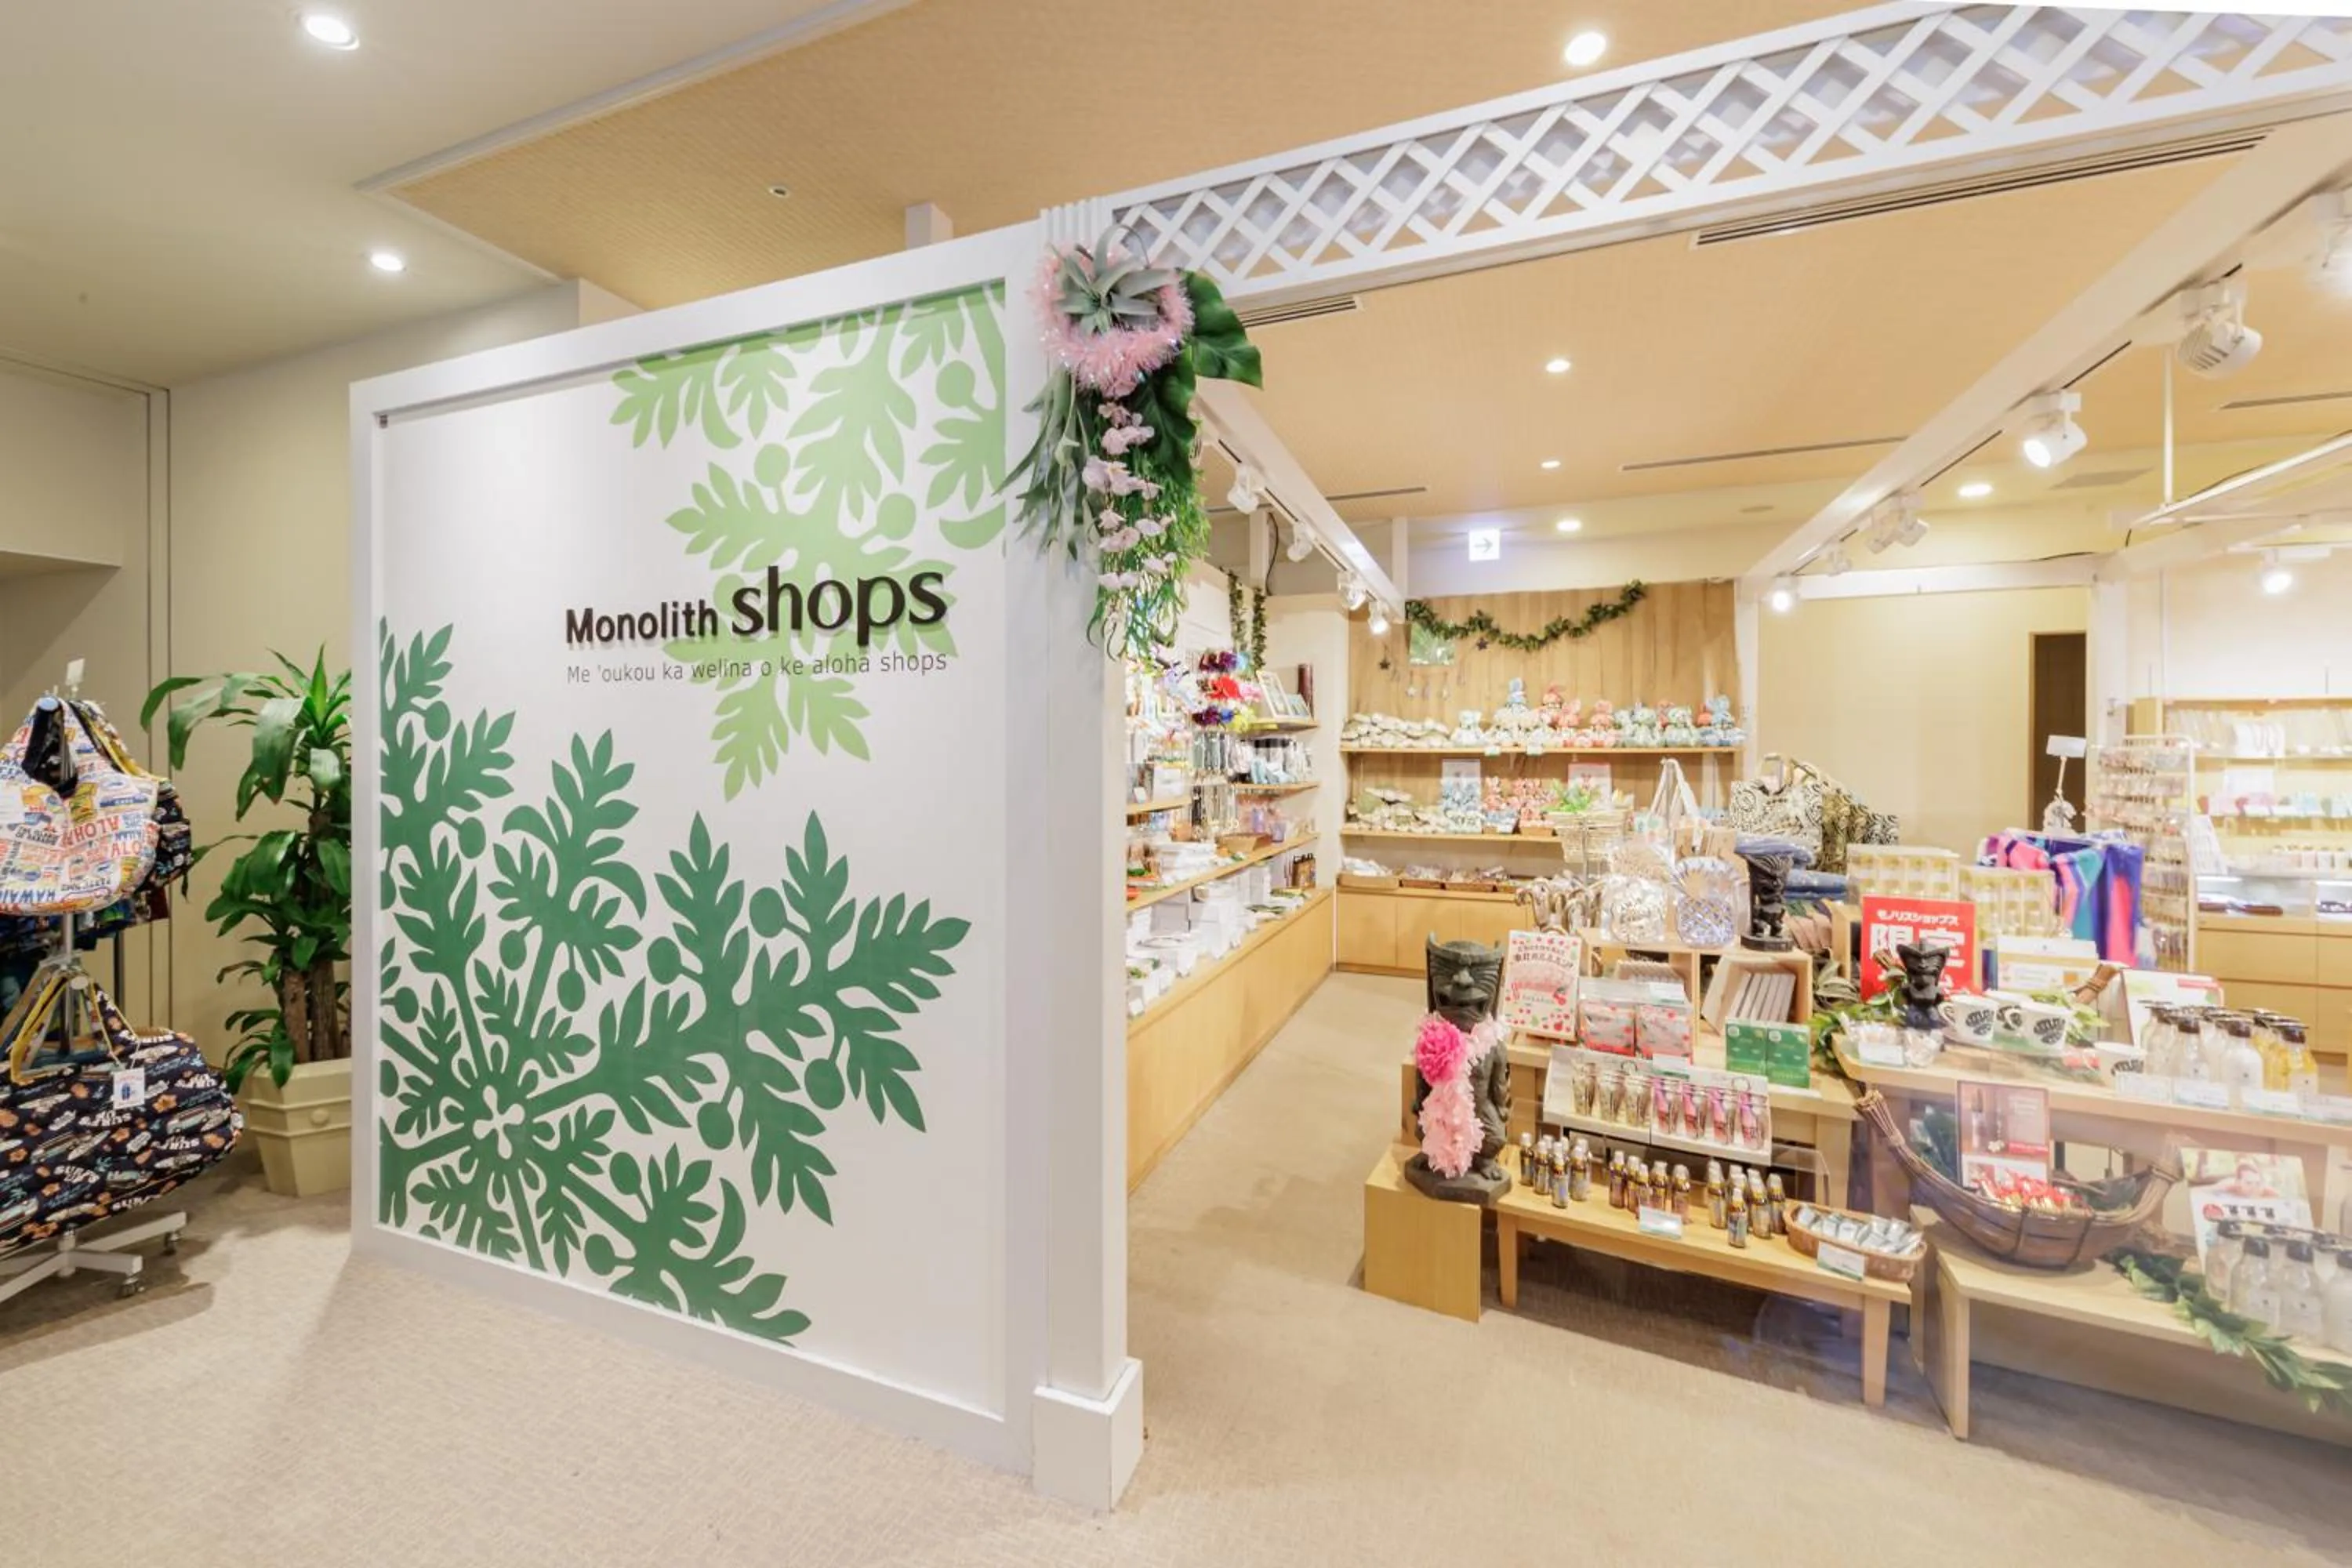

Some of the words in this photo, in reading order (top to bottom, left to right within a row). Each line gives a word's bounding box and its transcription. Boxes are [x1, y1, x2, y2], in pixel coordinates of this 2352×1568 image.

[566, 598, 718, 644] Monolith
[731, 565, 947, 647] shops
[567, 666, 590, 684] Me
[662, 662, 683, 680] ka
[691, 658, 752, 678] welina
[760, 661, 771, 677] o
[781, 655, 804, 675] ke
[813, 652, 869, 673] aloha
[880, 650, 946, 676] shops
